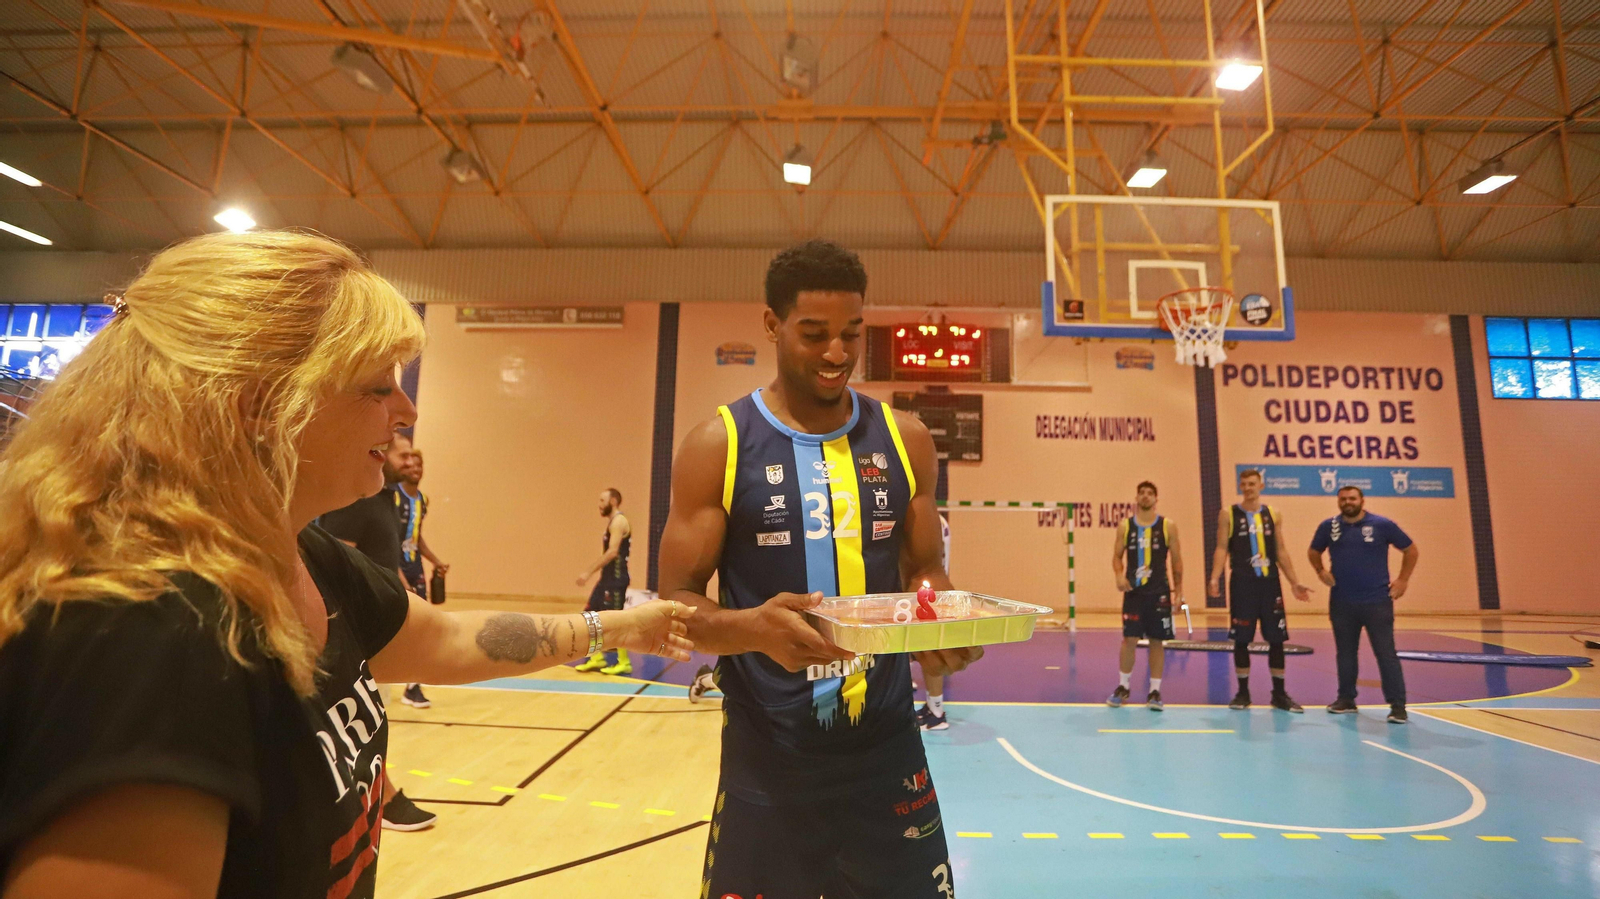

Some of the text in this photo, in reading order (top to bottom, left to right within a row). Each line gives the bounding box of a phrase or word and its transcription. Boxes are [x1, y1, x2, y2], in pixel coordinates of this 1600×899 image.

[902, 340, 920, 349] LOC
[953, 341, 973, 350] VISIT
[1222, 364, 1443, 391] POLIDEPORTIVO
[1264, 399, 1415, 424] CIUDAD DE
[1036, 413, 1155, 441] DELEGACIÓN MUNICIPAL
[1264, 434, 1420, 460] ALGECIRAS
[858, 457, 871, 465] Liga
[812, 476, 842, 485] hummel
[860, 468, 880, 476] LEB
[763, 511, 789, 519] Diputación
[804, 491, 859, 540] 32
[1038, 502, 1092, 527] DEPOTES
[807, 653, 876, 682] DRINK
[895, 804, 910, 816] TU
